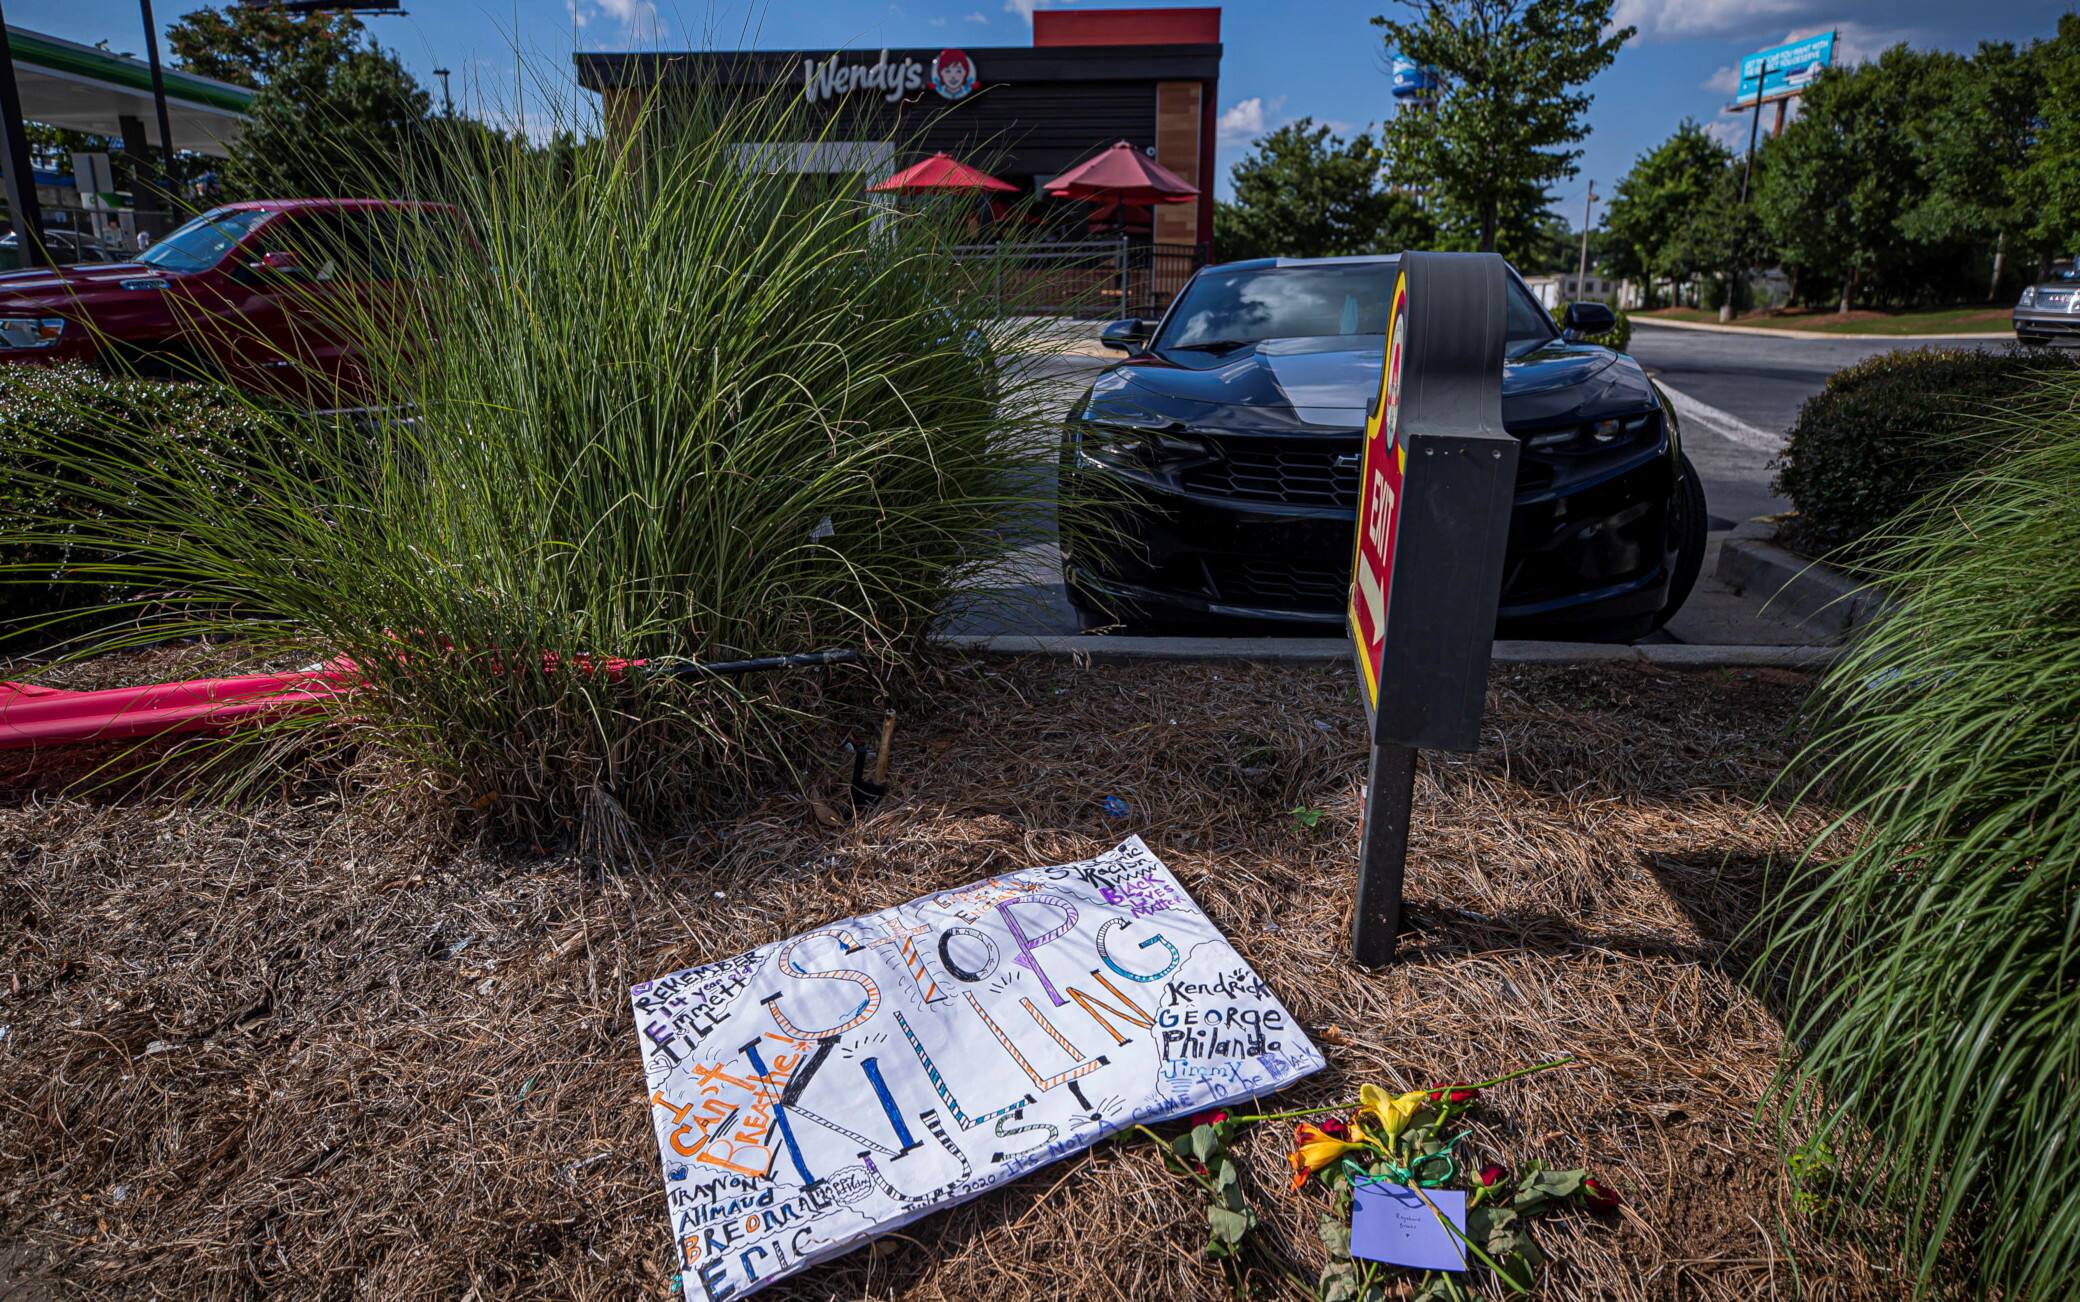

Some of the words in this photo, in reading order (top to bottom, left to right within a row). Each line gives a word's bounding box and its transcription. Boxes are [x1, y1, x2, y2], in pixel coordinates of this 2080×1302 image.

[804, 49, 923, 103] Wendy's
[1369, 468, 1395, 568] EXIT
[634, 951, 764, 1015] REMEMBER
[761, 894, 1078, 1040] STOP
[738, 917, 1180, 1191] KILLING
[668, 1175, 760, 1207] TRAYVON
